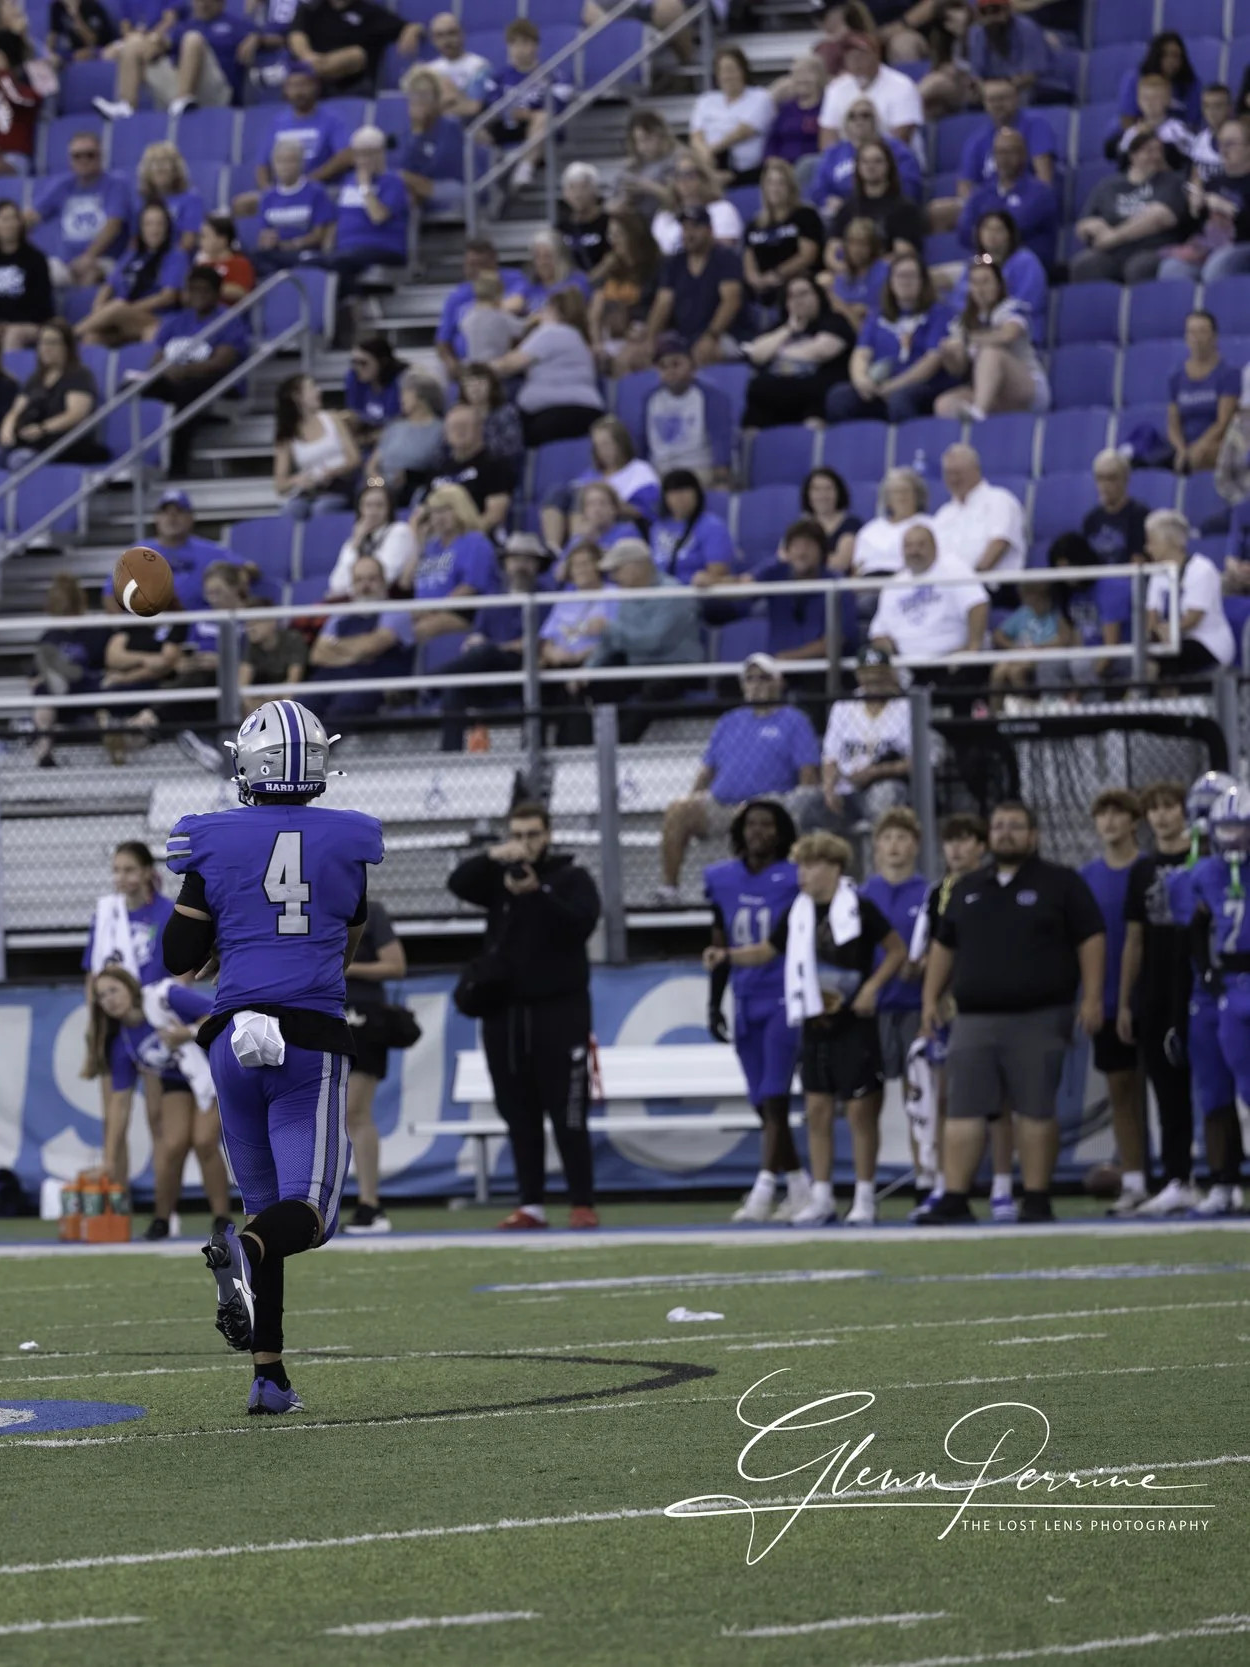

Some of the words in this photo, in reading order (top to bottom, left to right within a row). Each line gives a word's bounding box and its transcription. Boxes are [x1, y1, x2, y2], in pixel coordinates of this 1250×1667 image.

[265, 782, 294, 792] HARD
[297, 782, 321, 792] WAY
[261, 830, 311, 936] 4
[732, 906, 772, 946] 41
